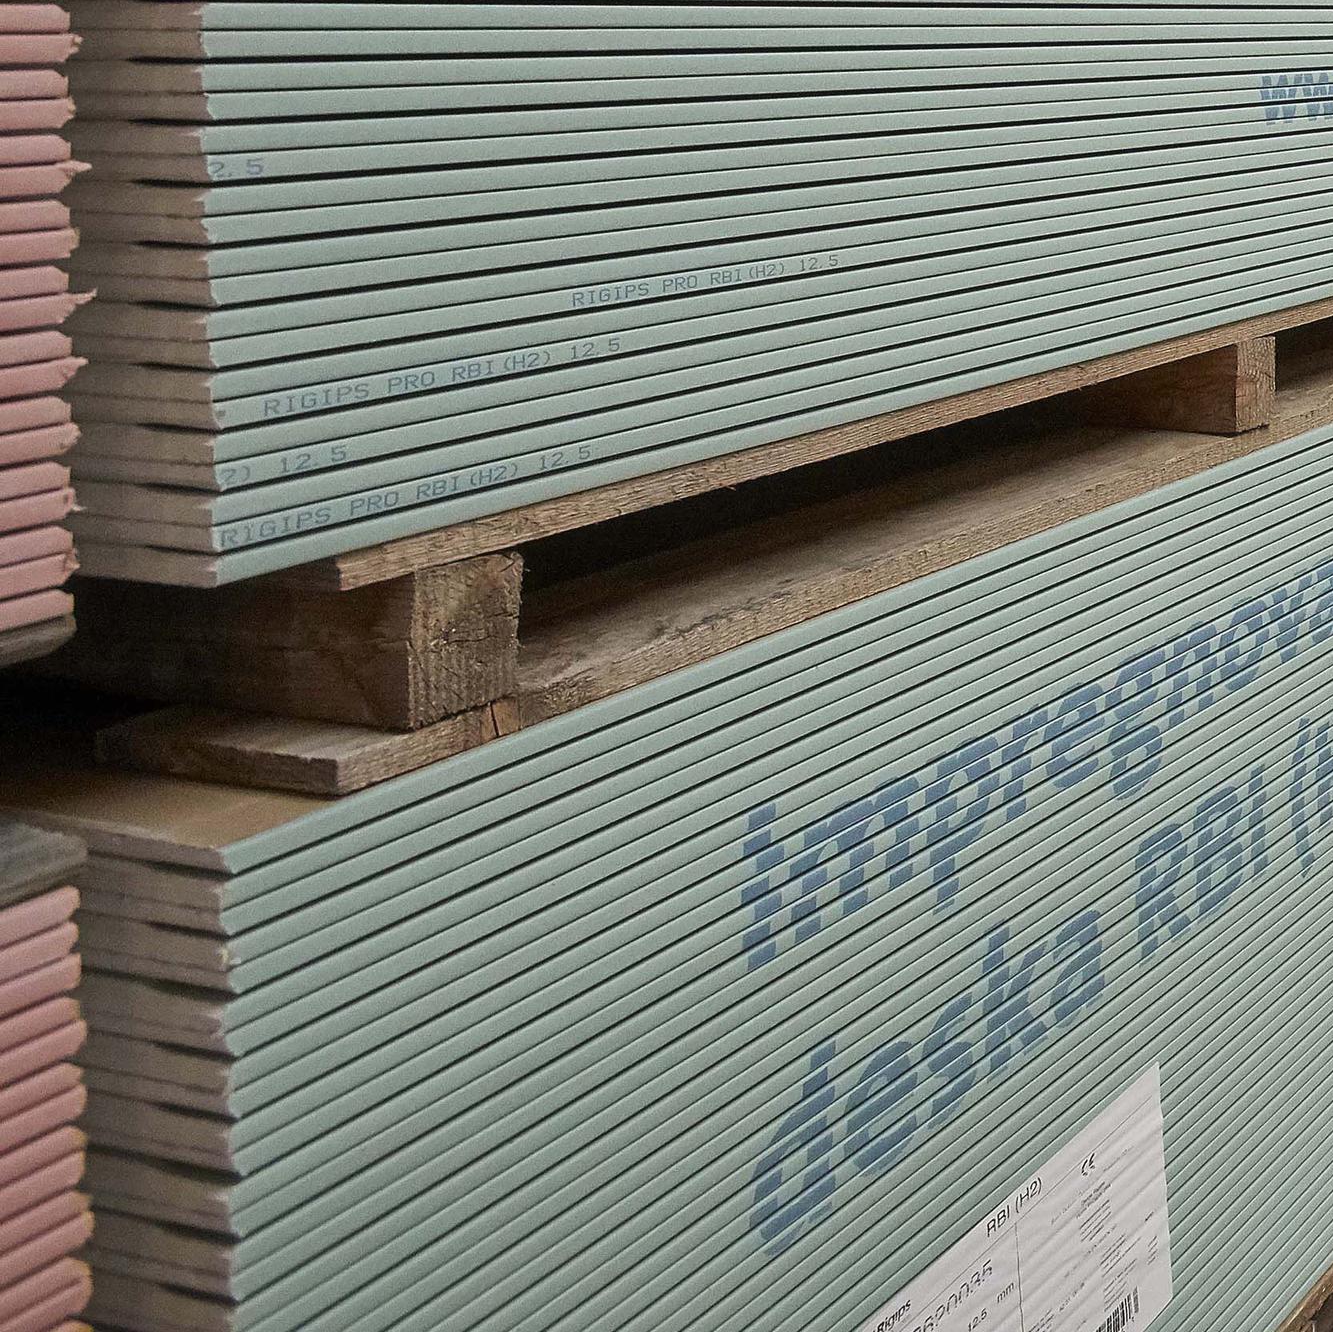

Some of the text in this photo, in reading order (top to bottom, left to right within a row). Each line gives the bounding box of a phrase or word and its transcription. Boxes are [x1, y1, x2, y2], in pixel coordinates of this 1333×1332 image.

[571, 279, 651, 309] RIGIPS
[661, 273, 700, 296] PRO
[797, 253, 841, 275] 12.5
[262, 379, 371, 419] RIGIPS
[386, 368, 438, 396] PRO
[568, 335, 623, 364] 12.5
[278, 442, 349, 475] 12.5
[218, 505, 332, 549] RIGIPS
[348, 487, 400, 524] PRO
[536, 443, 593, 474] 12.5
[750, 908, 1106, 1257] deska
[1133, 766, 1269, 966] RBI
[986, 1205, 1011, 1238] RBI
[1014, 1176, 1043, 1214] (H2)
[996, 1281, 1015, 1304] mm
